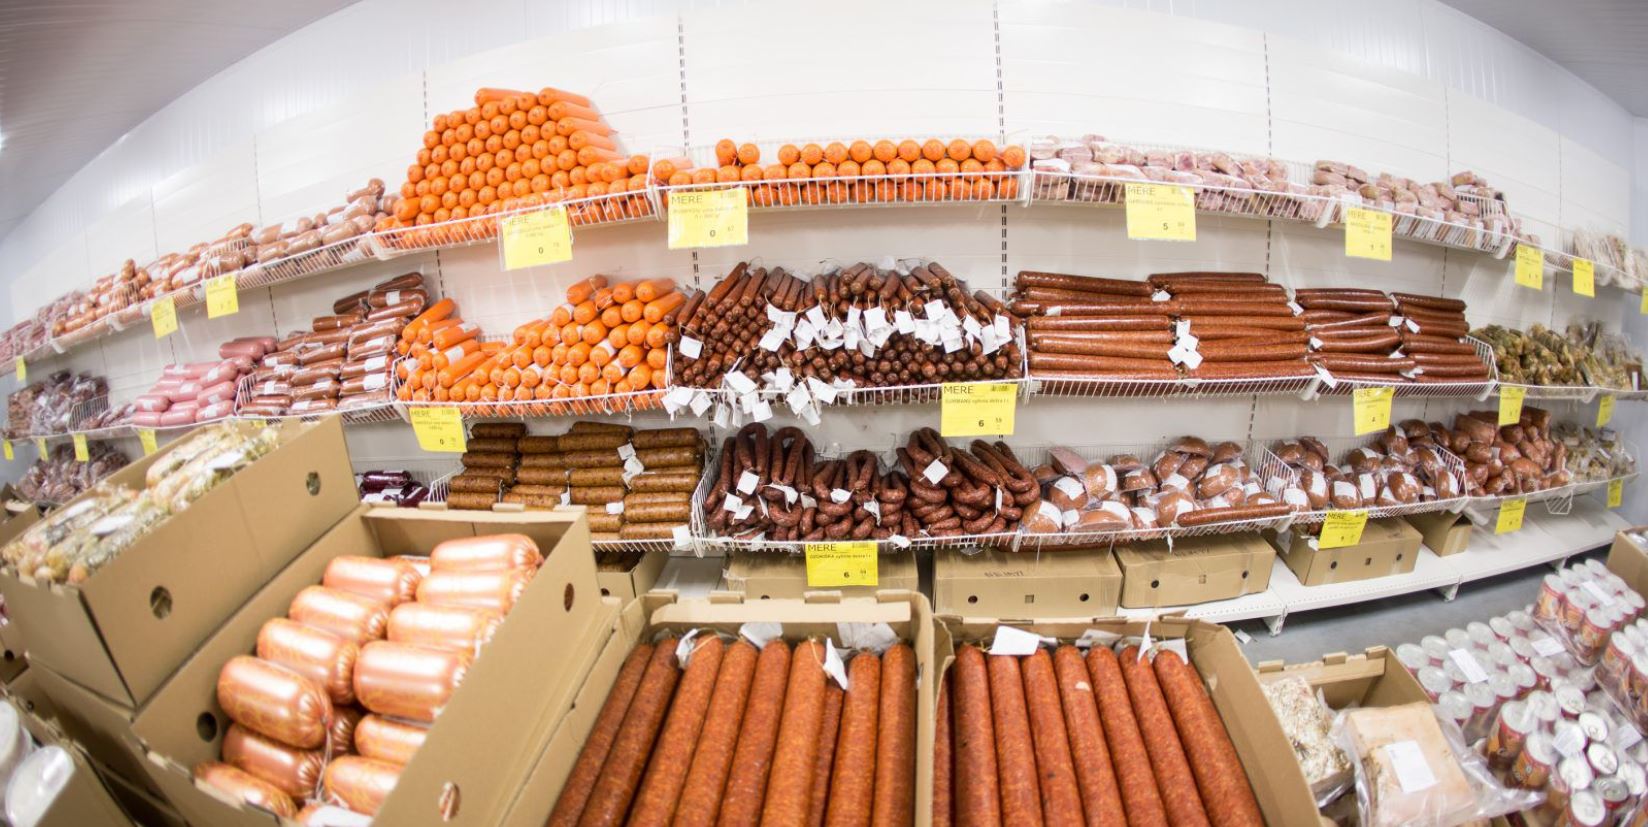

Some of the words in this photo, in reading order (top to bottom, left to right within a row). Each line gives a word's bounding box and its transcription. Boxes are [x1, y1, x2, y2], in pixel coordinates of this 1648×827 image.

[671, 194, 703, 205] MERE
[943, 385, 974, 395] MERE
[978, 419, 985, 428] 6
[807, 543, 837, 552] MERE
